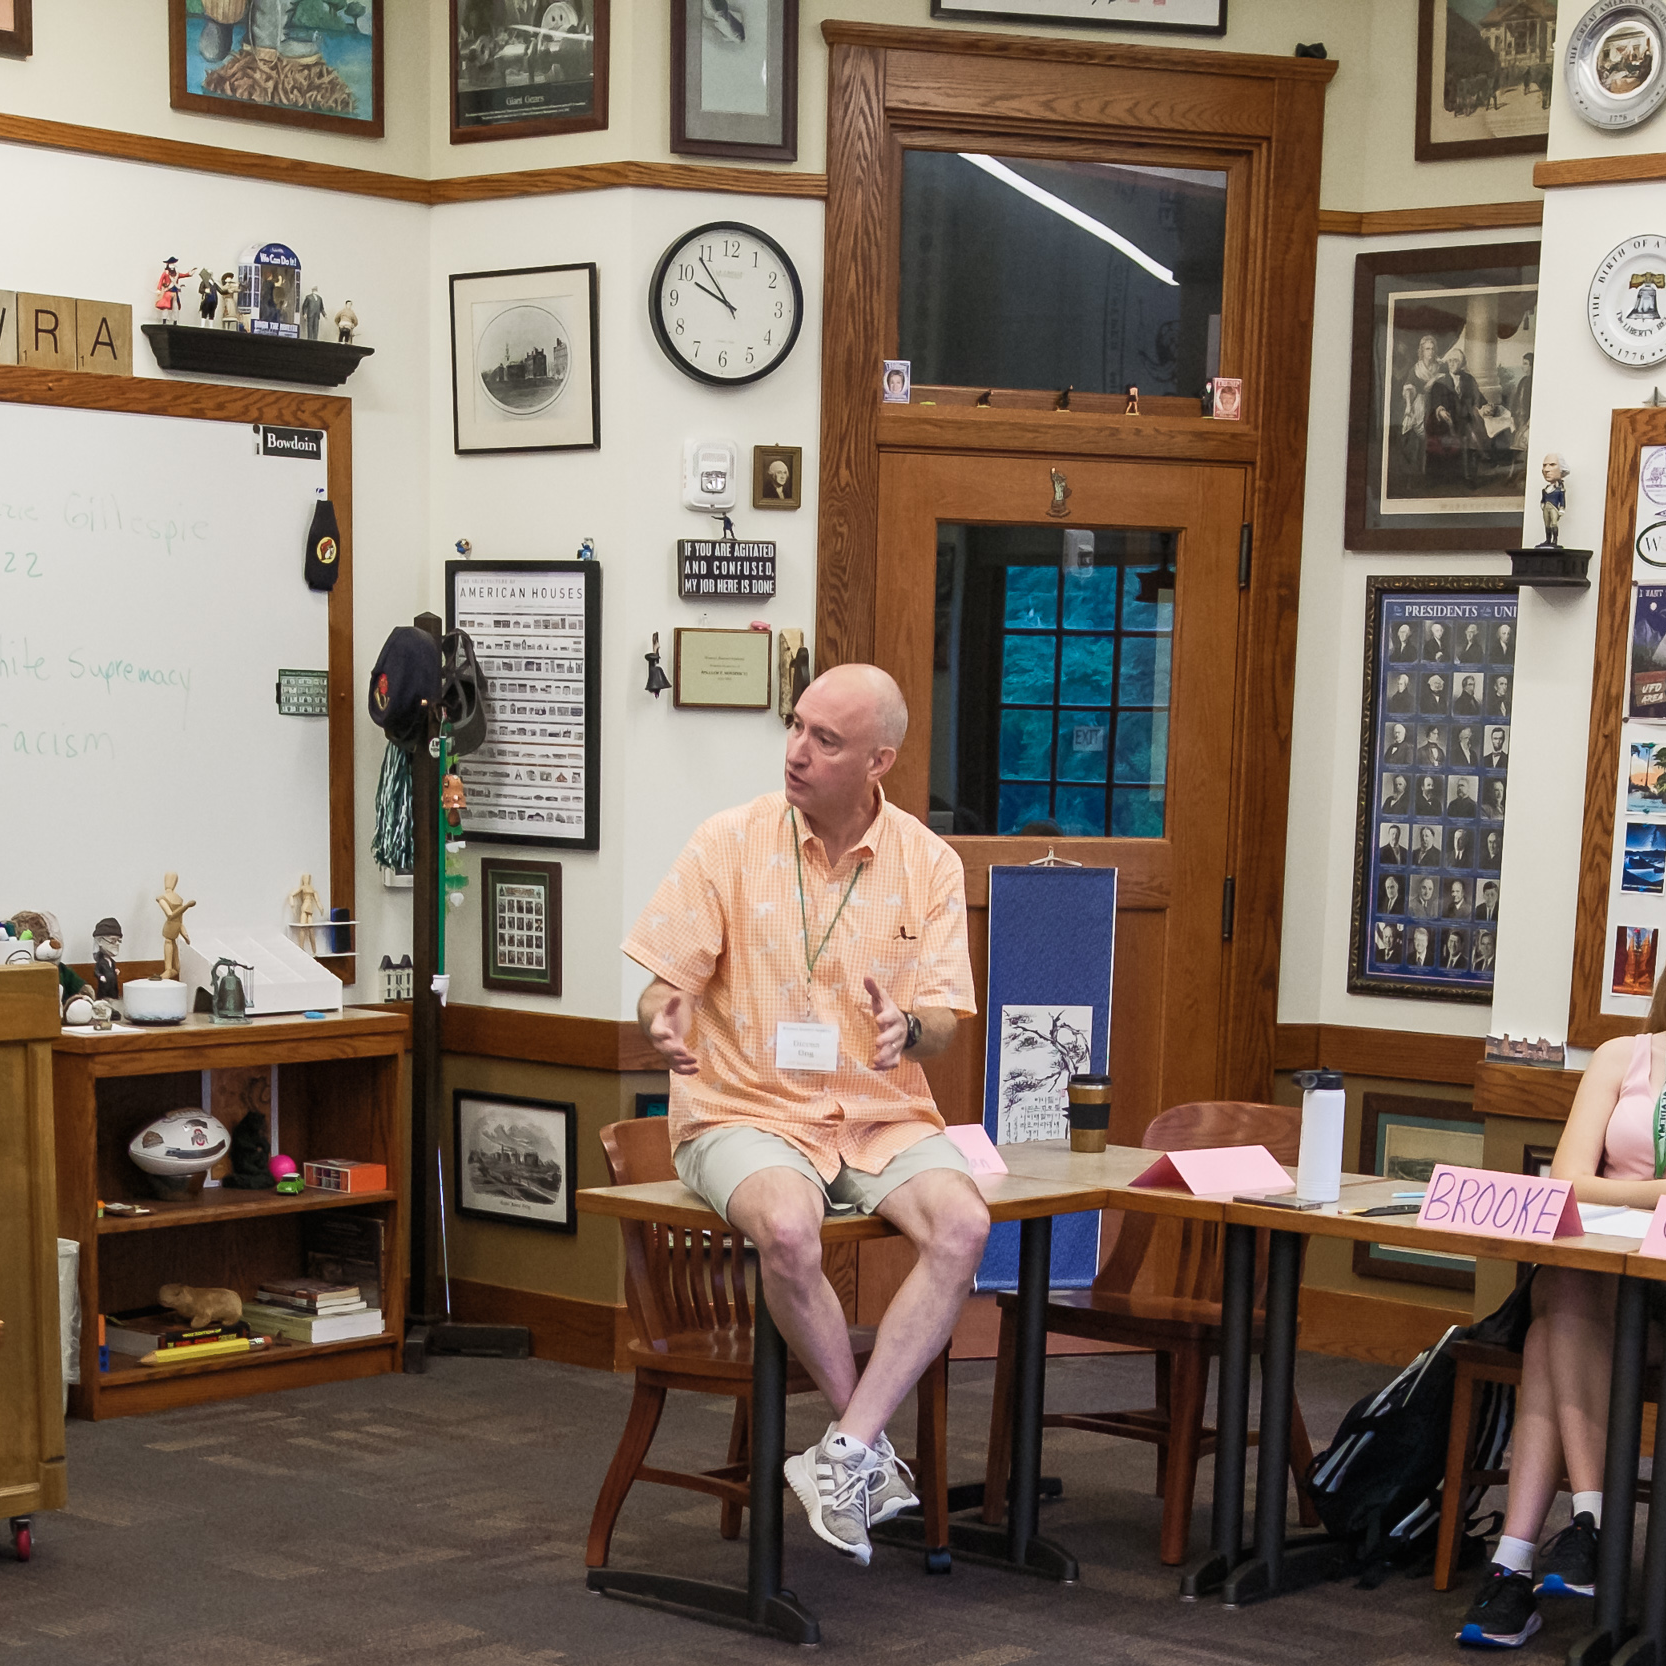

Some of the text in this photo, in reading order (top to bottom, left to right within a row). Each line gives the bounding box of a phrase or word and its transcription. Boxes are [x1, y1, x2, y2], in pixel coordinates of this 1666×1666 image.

[723, 240, 740, 258] 12
[1633, 239, 1647, 249] OF
[699, 245, 713, 262] 11
[752, 251, 759, 268] 1
[678, 264, 694, 282] 10
[768, 271, 777, 289] 2
[669, 289, 679, 307] 9
[774, 301, 783, 318] 3
[675, 318, 685, 335] 8
[763, 329, 772, 345] 4
[693, 340, 701, 358] 7
[745, 346, 754, 363] 5
[1617, 348, 1645, 361] 1776
[718, 350, 727, 368] 6
[266, 432, 317, 452] Bowdoin
[684, 542, 774, 558] IF YOU ARE AGITATED
[684, 561, 774, 577] AND CONFUSED,
[460, 587, 583, 599] AMERICAN HOUSES
[684, 579, 774, 594] MY JOB HERE IS DONE
[1646, 589, 1663, 597] WANT
[1405, 604, 1478, 618] PRESIDENTS
[1641, 683, 1662, 693] UFO
[1641, 692, 1664, 704] AREA
[1424, 1172, 1567, 1236] BROOKE
